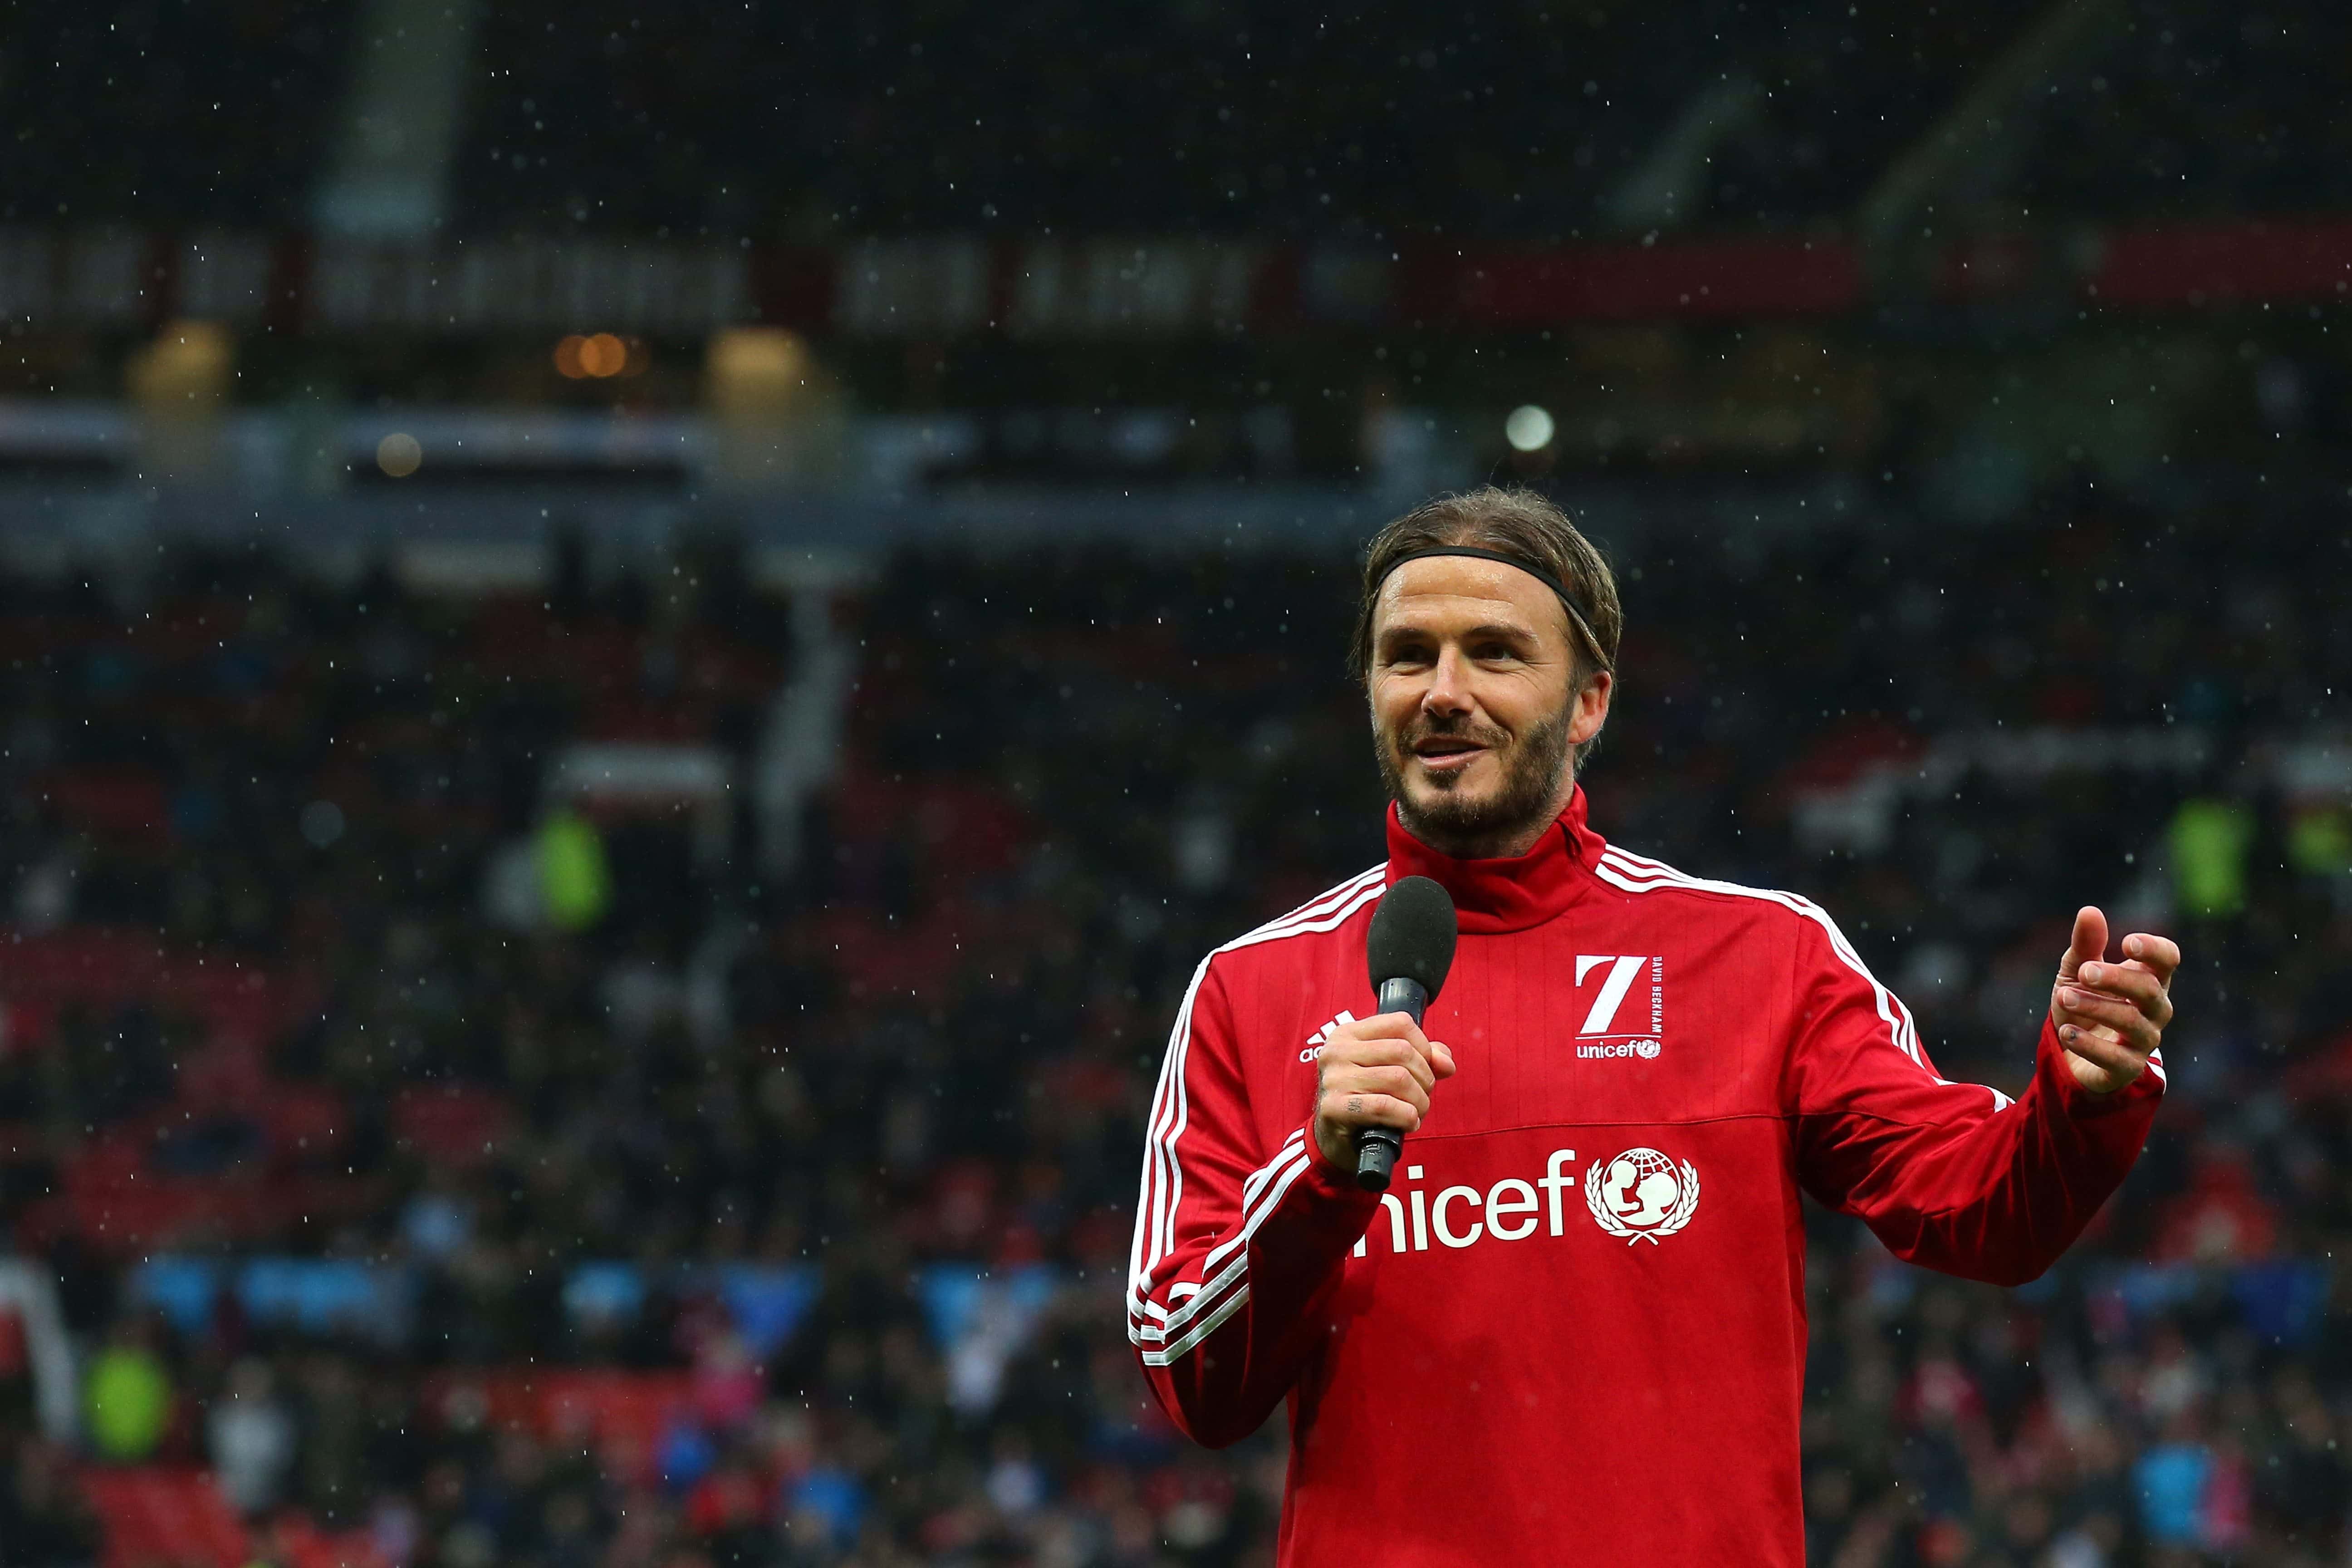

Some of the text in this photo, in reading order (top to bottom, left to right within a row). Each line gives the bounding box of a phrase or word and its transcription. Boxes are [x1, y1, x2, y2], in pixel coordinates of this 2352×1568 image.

[1575, 955, 1648, 1034] 7
[1651, 956, 1663, 1033] DAVID BECKHAM
[1577, 1039, 1637, 1059] unicef
[1346, 1149, 1575, 1259] nicef
